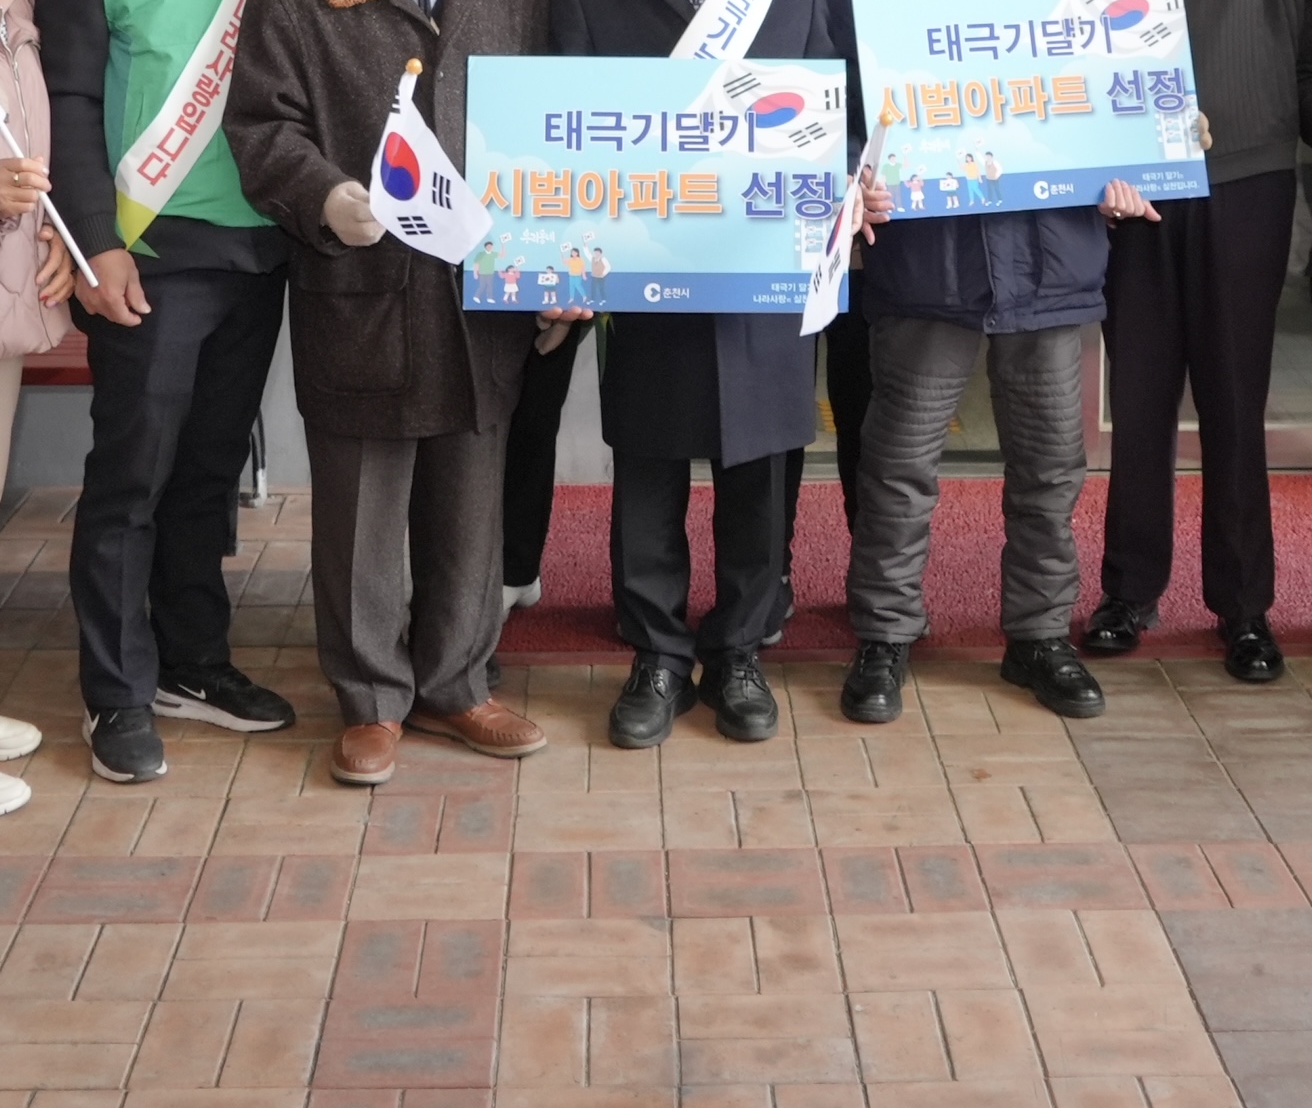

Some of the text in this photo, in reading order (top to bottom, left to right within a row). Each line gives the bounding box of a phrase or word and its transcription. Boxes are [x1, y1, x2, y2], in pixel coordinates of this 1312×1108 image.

[927, 16, 1113, 62] 태극기달기
[879, 68, 1186, 129] 시범아파트 선정
[544, 111, 756, 153] 태극기달기
[481, 168, 834, 219] 시범아파트 선정
[1050, 183, 1074, 195] 춘천시
[663, 287, 690, 300] 춘천시
[771, 283, 796, 292] 태극기
